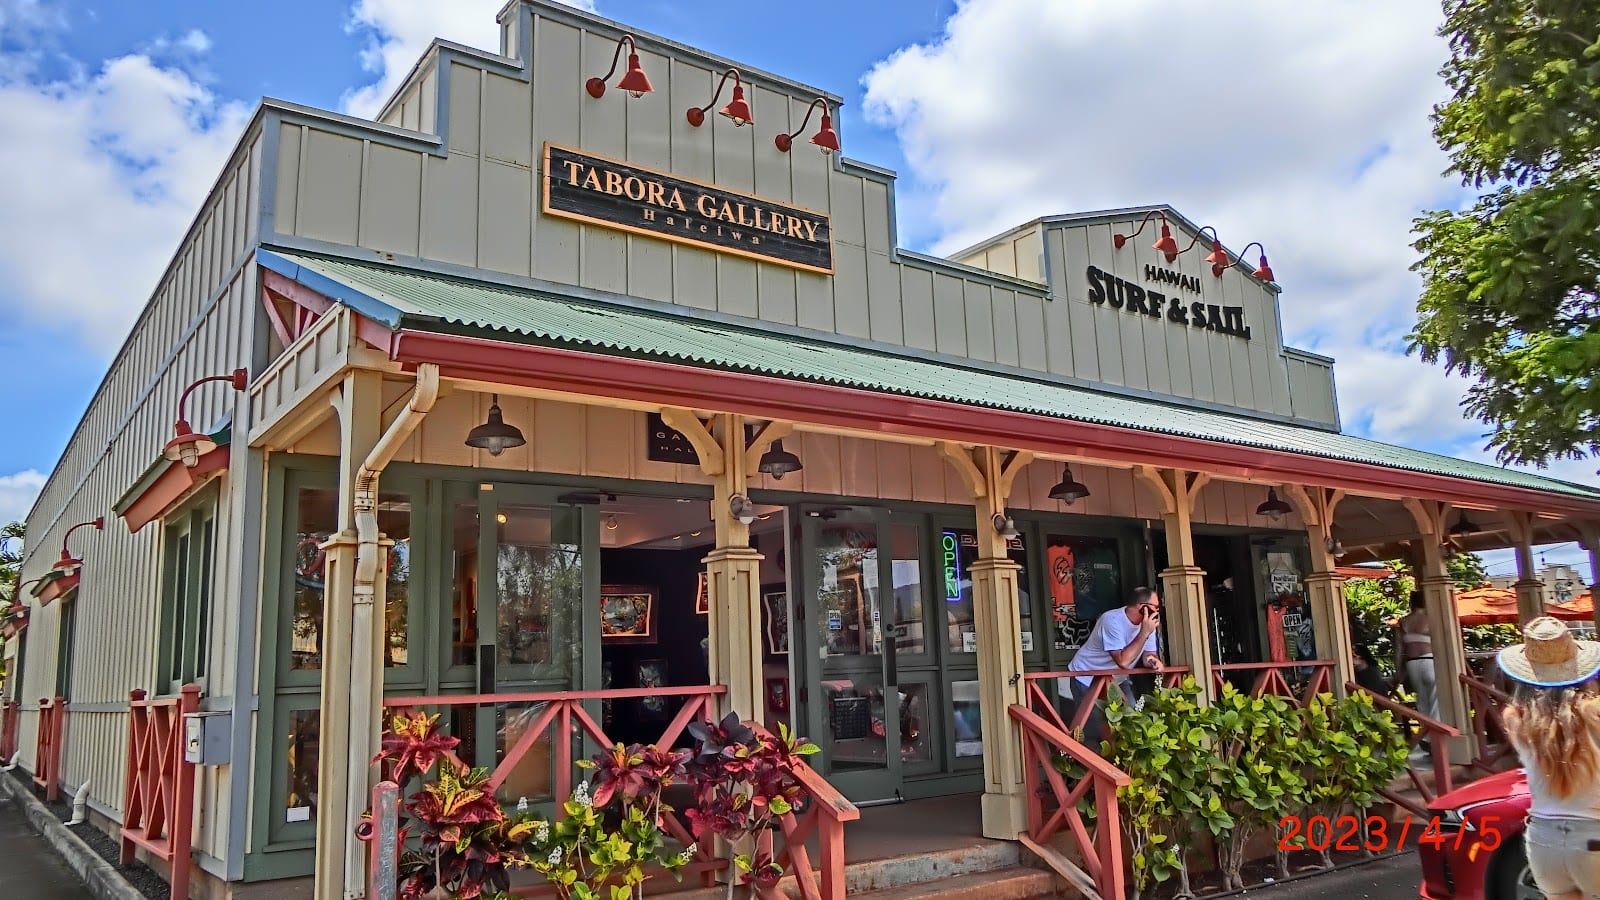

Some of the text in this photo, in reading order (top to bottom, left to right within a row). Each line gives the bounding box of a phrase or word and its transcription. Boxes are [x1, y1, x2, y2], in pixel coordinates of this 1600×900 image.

[563, 160, 820, 243] TABORA GALLERY
[644, 209, 761, 246] Haleiwa
[1087, 265, 1251, 340] SURF & SAIL
[1145, 263, 1201, 295] HAWAII
[942, 536, 958, 597] OPEN
[1283, 615, 1301, 627] OPEN
